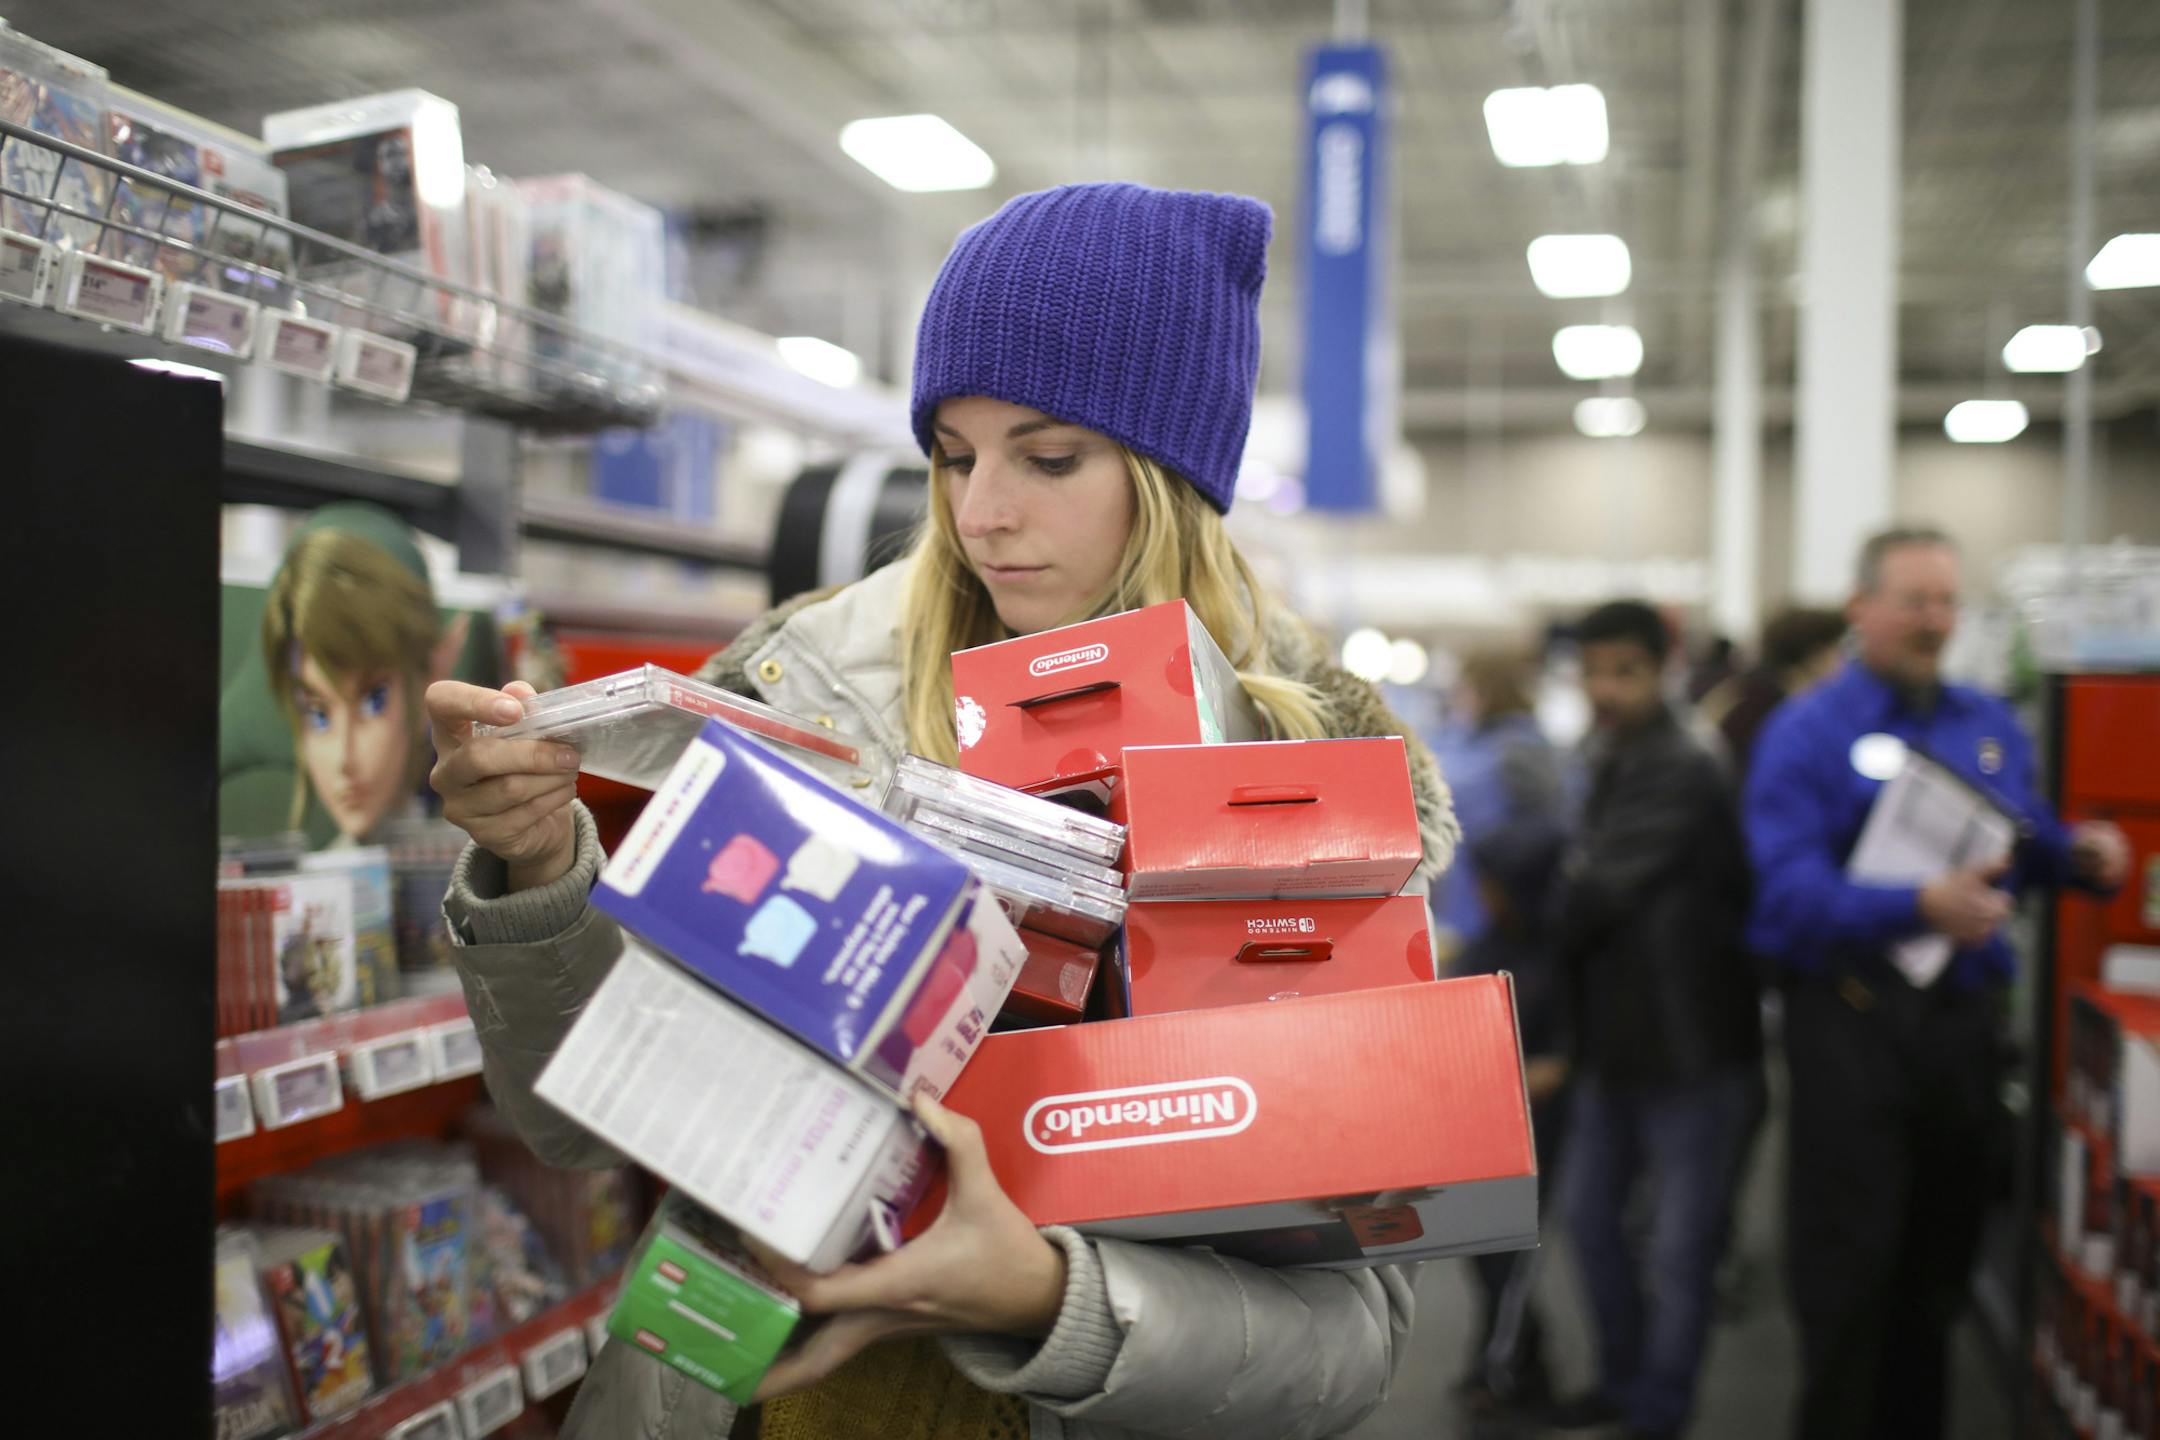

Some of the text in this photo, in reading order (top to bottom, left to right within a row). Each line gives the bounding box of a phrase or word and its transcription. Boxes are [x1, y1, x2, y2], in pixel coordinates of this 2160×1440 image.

[1037, 648, 1102, 671] Nintendo
[1246, 918, 1297, 928] SWITCH
[1043, 1090, 1236, 1138] Nintendo
